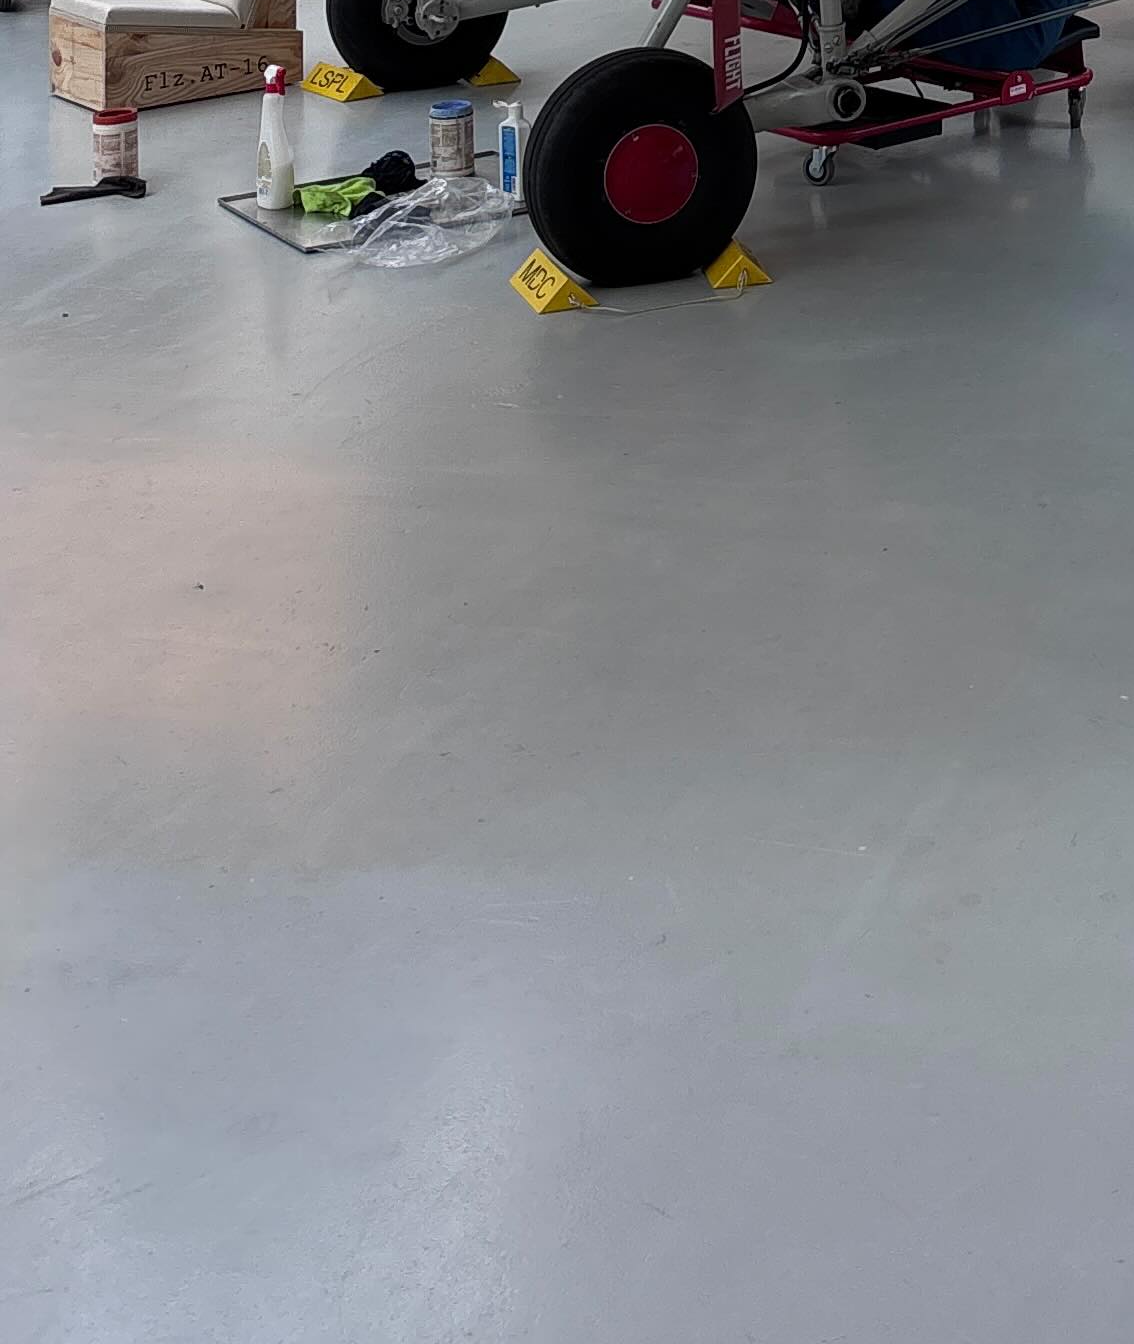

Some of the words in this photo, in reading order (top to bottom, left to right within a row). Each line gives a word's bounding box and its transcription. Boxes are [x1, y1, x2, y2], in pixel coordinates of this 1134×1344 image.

[309, 67, 349, 94] LSPL
[724, 35, 742, 91] FLIGHT
[518, 258, 556, 300] MDC
